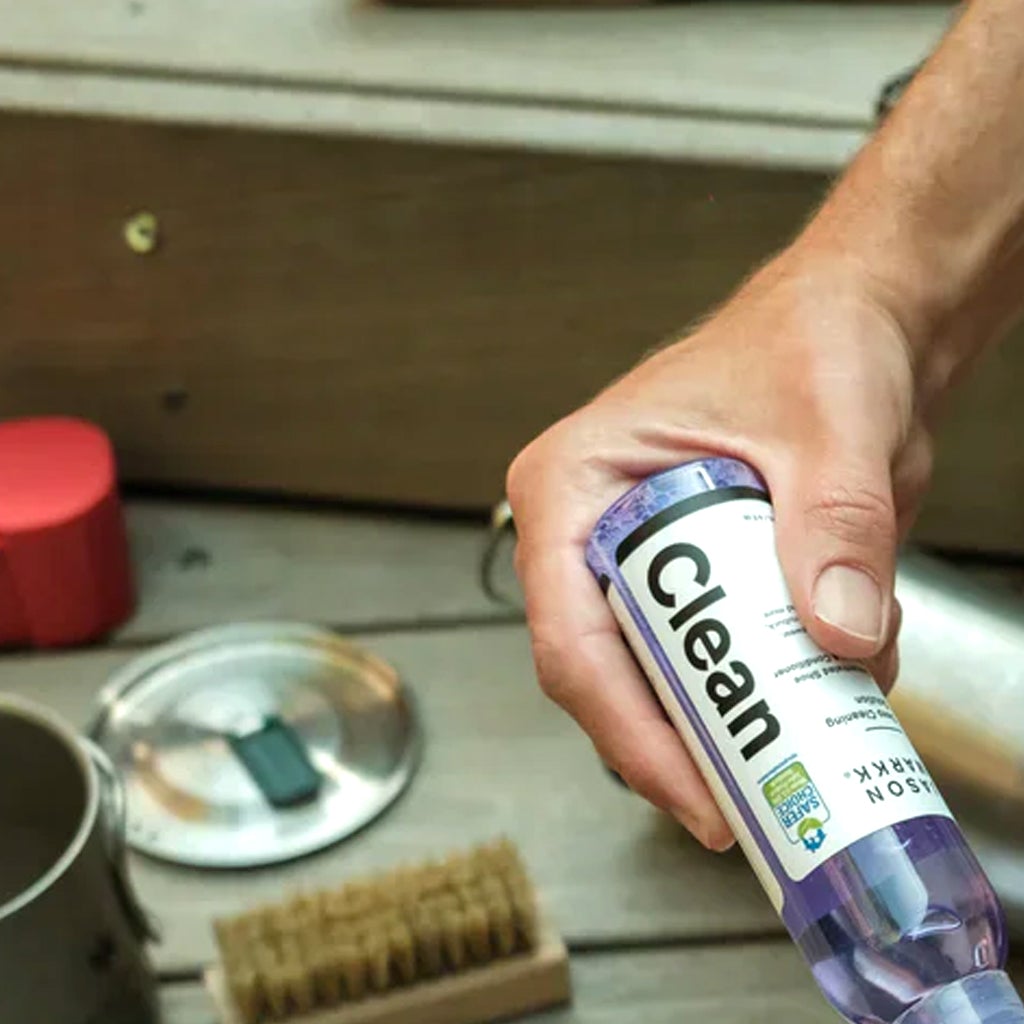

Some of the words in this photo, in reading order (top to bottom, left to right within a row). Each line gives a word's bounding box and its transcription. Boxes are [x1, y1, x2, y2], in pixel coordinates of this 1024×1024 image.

[647, 542, 781, 761] Clean
[825, 709, 877, 728] Cleaning
[774, 784, 816, 817] CHOICE
[866, 777, 936, 804] ASON
[781, 795, 820, 828] SAFER
